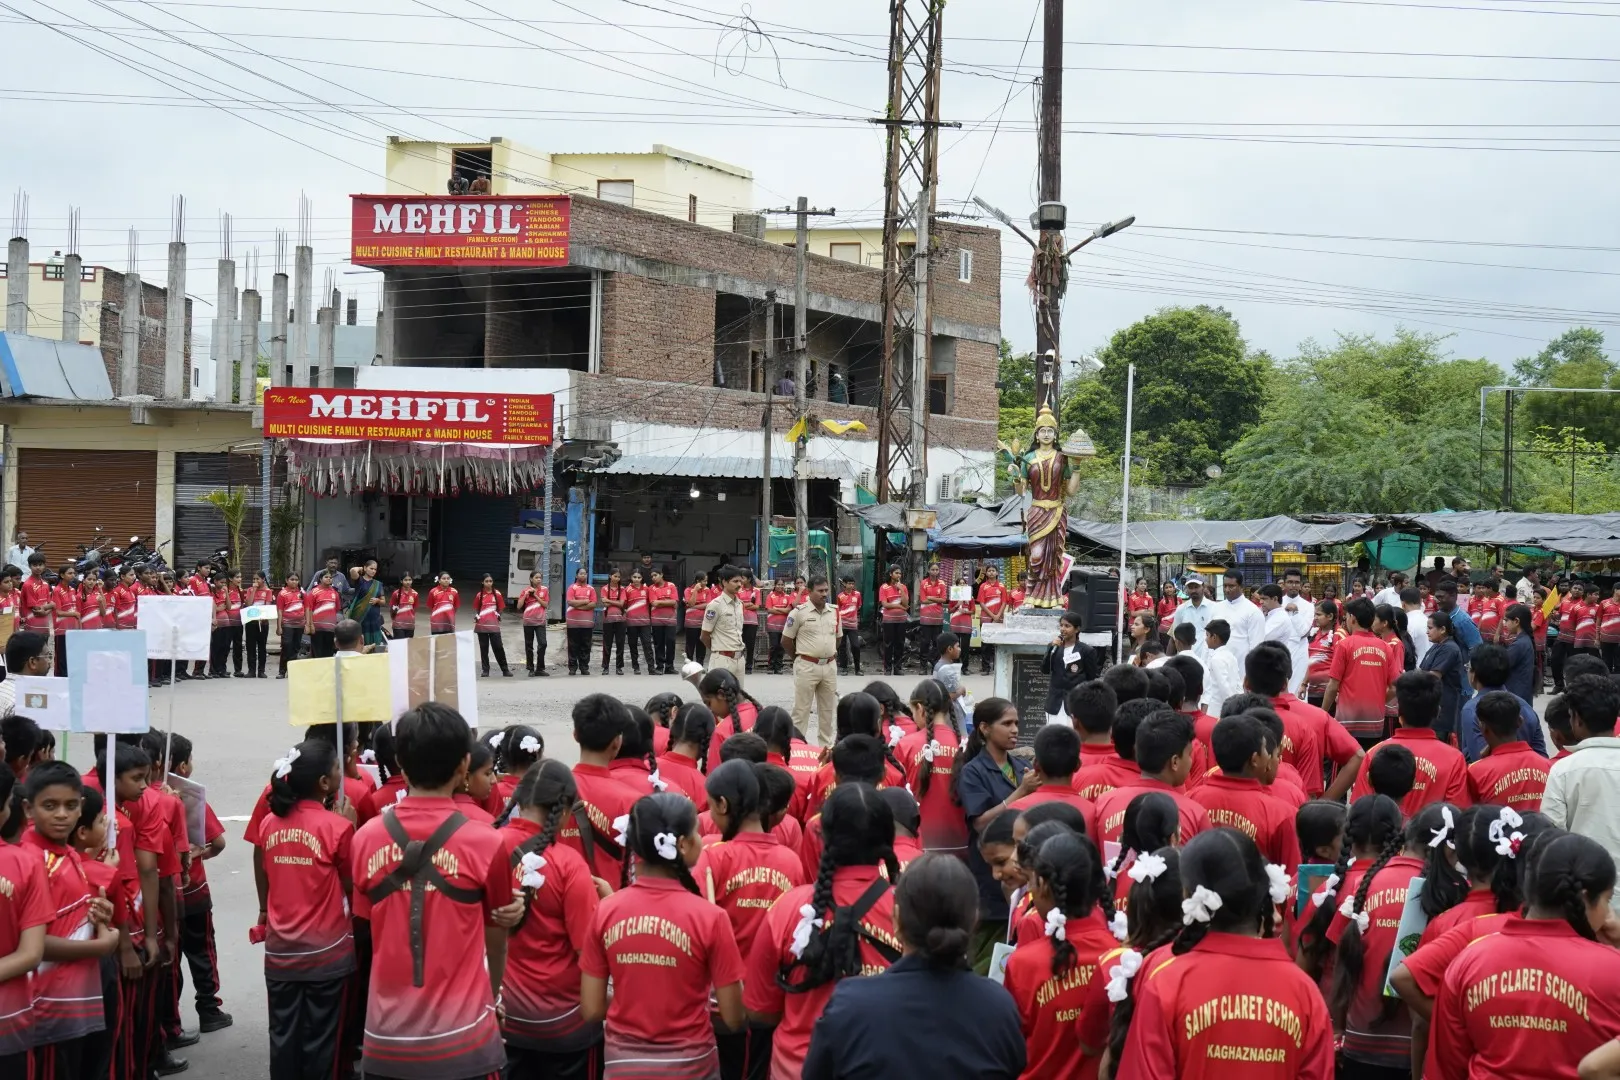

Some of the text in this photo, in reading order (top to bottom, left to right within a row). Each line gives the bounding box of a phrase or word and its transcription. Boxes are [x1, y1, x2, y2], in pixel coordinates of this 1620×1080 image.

[372, 203, 520, 234] MEHFIL
[356, 246, 564, 258] MULTI CUISINE FAMILY RESTAURANT & MANDI HOUSE
[270, 395, 306, 404] The New
[309, 394, 490, 422] MEHFIL
[270, 424, 492, 440] MULTI CUISINE FAMILY RESTAURANT & MANDI HOUSE
[1418, 756, 1438, 784] SCHOOL
[1494, 772, 1512, 796] SAINT
[1511, 768, 1532, 784] CLARET
[587, 804, 610, 836] SCHOOL
[1208, 809, 1258, 842] CLARET SCHOOL
[280, 828, 302, 843] CLARET
[302, 830, 322, 858] SCHOOL
[274, 856, 312, 866] KAGHAZNAGAR
[368, 844, 390, 879] SAINT
[603, 916, 692, 956] SAINT CLARET SCHOOL
[616, 953, 677, 968] KAGHAZNAGAR
[1466, 968, 1590, 1022] SAINT CLARET SCHOOL
[1186, 994, 1302, 1048] SAINT CLARET SCHOOL
[1489, 1015, 1568, 1032] KAGHAZNAGAR
[1207, 1044, 1286, 1062] KAGHAZNAGAR
